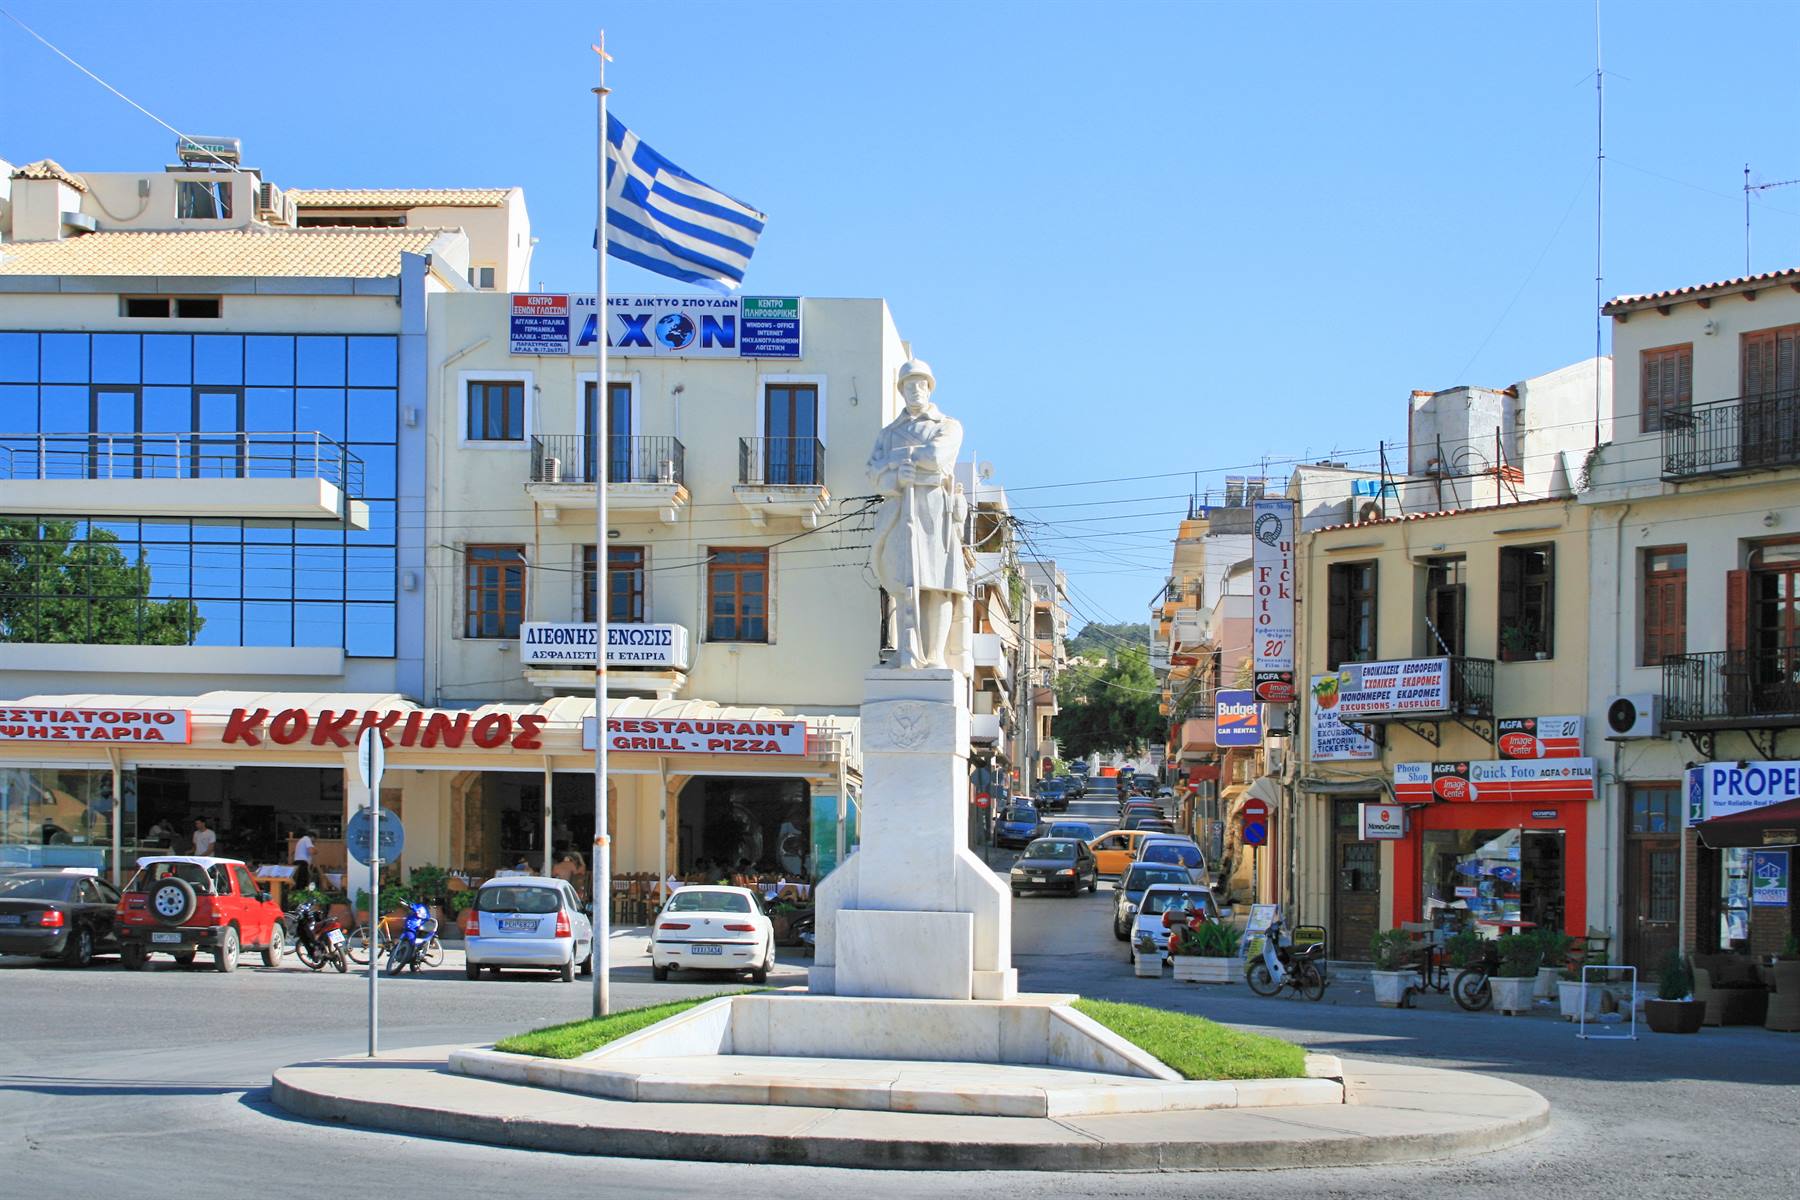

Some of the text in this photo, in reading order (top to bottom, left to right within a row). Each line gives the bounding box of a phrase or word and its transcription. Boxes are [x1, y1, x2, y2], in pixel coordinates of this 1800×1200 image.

[527, 297, 553, 305] ΚΕΝΤΡΟ
[576, 298, 738, 307] ΔΙΕΝΕΣ ΔΙΚΤΥΟ ΣΠΟΥΔΩΝ
[758, 300, 784, 308] ΚΕΝΤΡΟ
[744, 309, 797, 318] ΠΛΗΡΟΦΟΡΙΚΗΣ
[526, 628, 671, 646] ΔΙΕΘΝΗΣ ΕΝΩΣΙΣ
[532, 650, 665, 661] ΑΣΦΑΛΙΣΤΙΗ ΕΤΑΙΡΙΑ
[1403, 662, 1442, 674] ΛΕΩΦΟΡΕΙΩΝ
[1364, 676, 1440, 689] ΣΧΟΛΙΚΕΣ ΕΚΔΡΟΜΕΣ
[1341, 688, 1440, 702] ΜΟΝΟΗΜΕΡΕΣ ΕΚΔΡΟΜΕΣ
[1218, 702, 1257, 718] Budget
[1341, 699, 1440, 711] EXCURSIONS AUSFLÜGE
[221, 708, 547, 749] ΚΟΚΚΙΝΟΣ
[606, 720, 794, 736] RESTAURANT
[1499, 720, 1523, 729] AGFA
[612, 736, 782, 752] GRILL PIZZA
[1317, 736, 1356, 745] SANTORINI
[1509, 736, 1532, 746] Image
[1317, 744, 1349, 753] TICKETS
[1508, 746, 1532, 755] Center
[1397, 764, 1420, 773] Photo
[1434, 765, 1456, 773] AGFA
[1472, 764, 1591, 780] Quick Foto AGFA FILM
[1408, 772, 1428, 783] Shop
[1713, 768, 1800, 796] PROPE
[1443, 779, 1465, 790] Image
[1443, 789, 1465, 798] Center
[1368, 823, 1401, 831] MoneyGram
